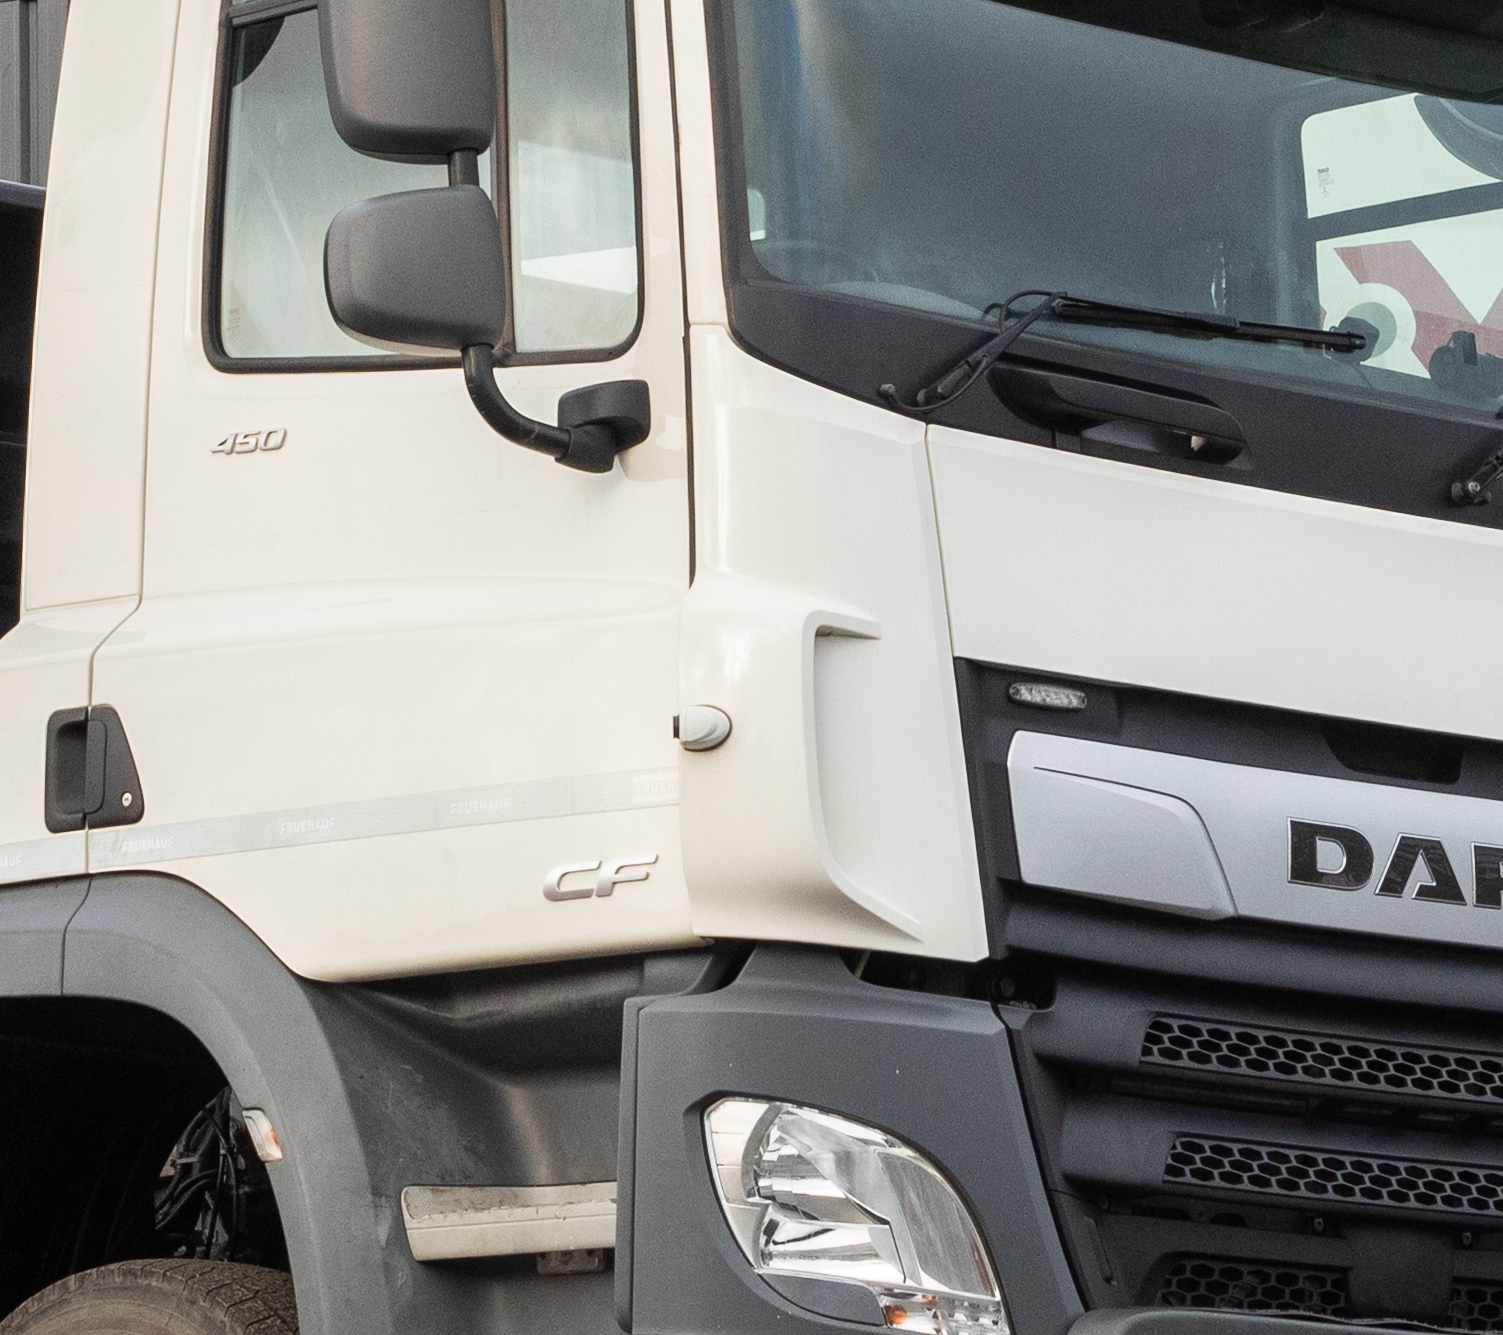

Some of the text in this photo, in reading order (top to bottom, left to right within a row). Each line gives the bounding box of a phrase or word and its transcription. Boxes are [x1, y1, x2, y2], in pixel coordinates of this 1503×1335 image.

[210, 427, 287, 455] 450
[449, 796, 512, 817] FRUEHAUF
[279, 816, 336, 836] FRUEHAUF
[122, 835, 174, 854] FRUEHAUF
[542, 854, 659, 902] CF
